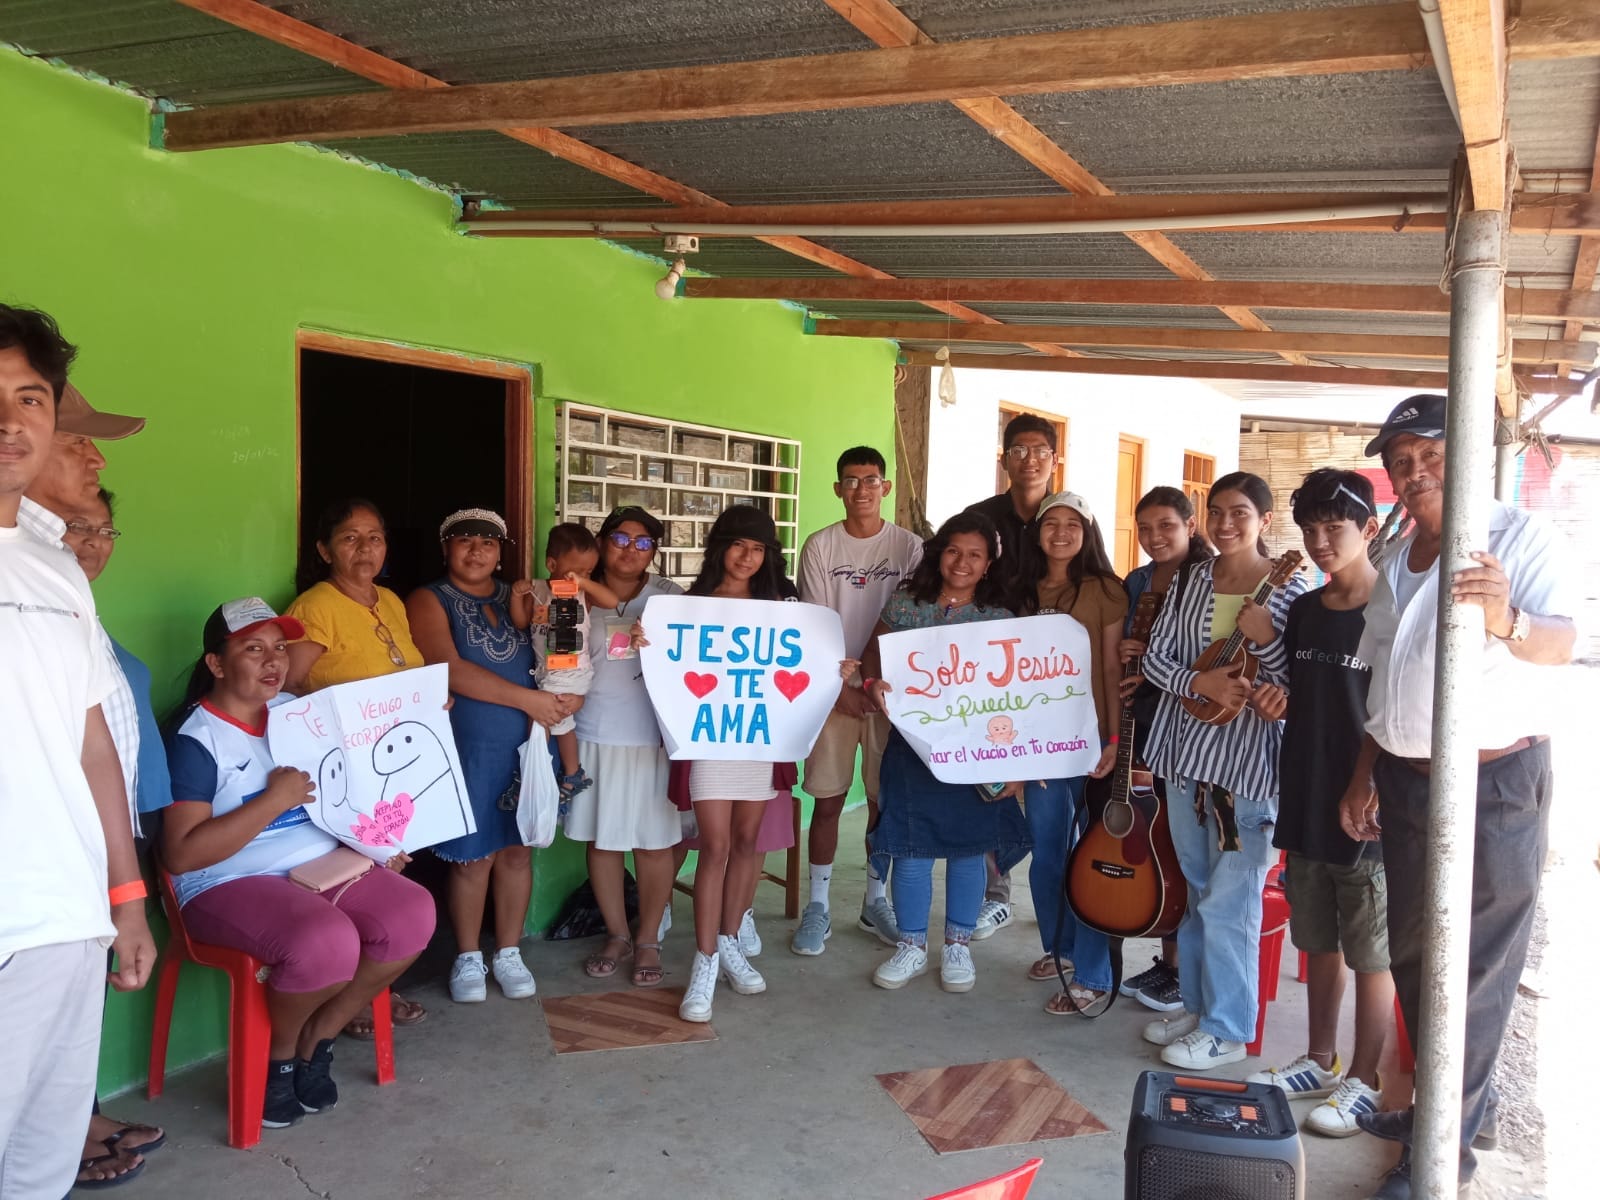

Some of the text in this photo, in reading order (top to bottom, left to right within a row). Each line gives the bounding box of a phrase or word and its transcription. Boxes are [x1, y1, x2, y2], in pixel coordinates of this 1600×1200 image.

[667, 624, 803, 668] JESUS
[726, 668, 765, 699] TE
[904, 638, 1081, 698] Sólo Jesús
[358, 697, 402, 720] VENGO
[691, 703, 771, 745] AMA
[928, 751, 951, 763] nar
[954, 746, 967, 763] el
[1011, 744, 1028, 757] en
